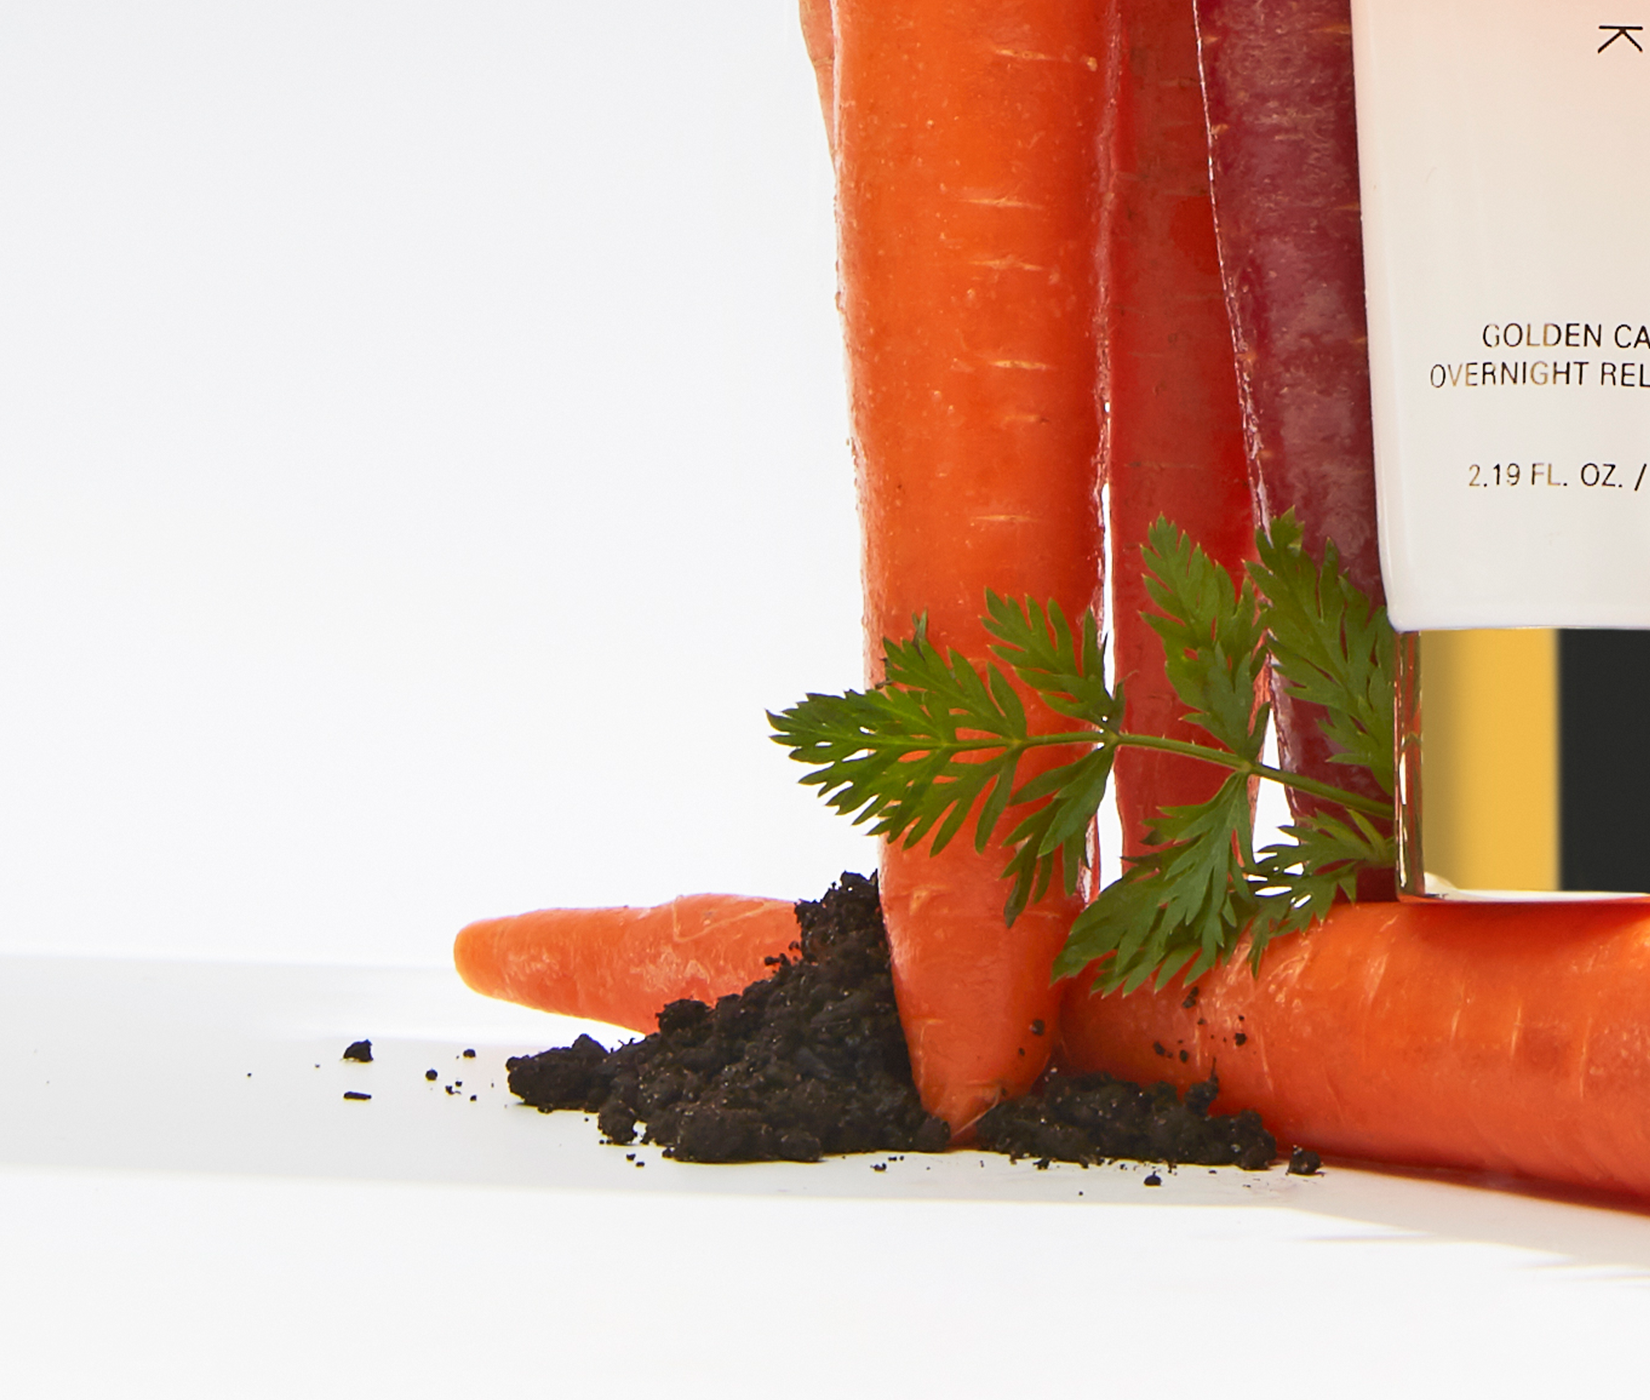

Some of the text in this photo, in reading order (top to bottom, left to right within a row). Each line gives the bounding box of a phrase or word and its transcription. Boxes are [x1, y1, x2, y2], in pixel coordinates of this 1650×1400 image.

[1482, 322, 1602, 349] GOLDEN
[1430, 360, 1590, 388] OVERNIGHT
[1468, 463, 1521, 488] 2.19
[1531, 463, 1568, 487] FL.
[1580, 463, 1624, 488] OZ.
[1634, 463, 1648, 491] /
